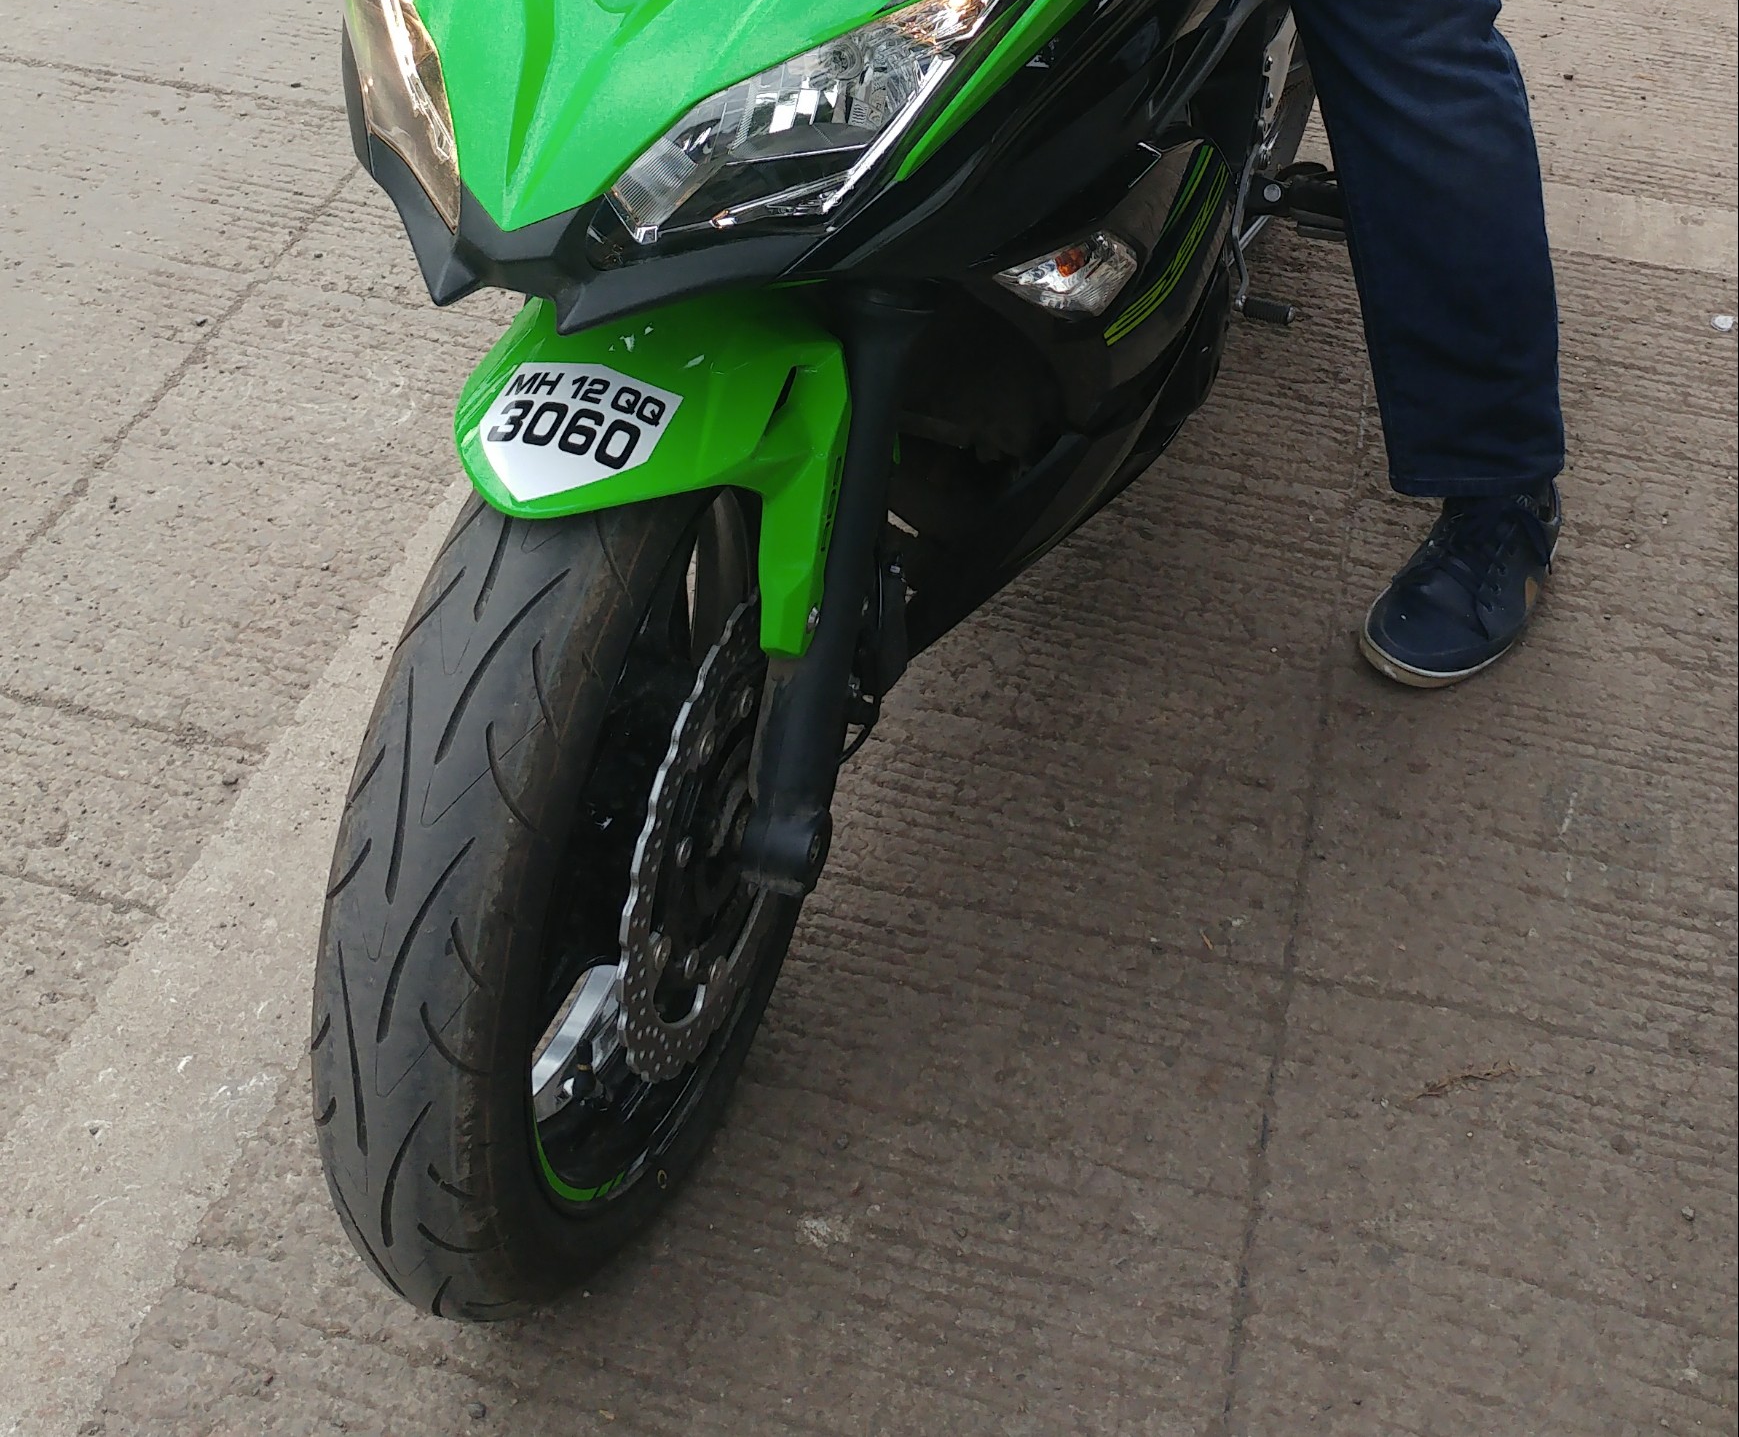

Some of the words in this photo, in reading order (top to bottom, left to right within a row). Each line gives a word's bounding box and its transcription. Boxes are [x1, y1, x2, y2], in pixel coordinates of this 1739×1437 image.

[504, 371, 566, 397] MH
[570, 375, 611, 405] 12
[610, 386, 667, 428] QQ
[486, 399, 641, 470] 3060
